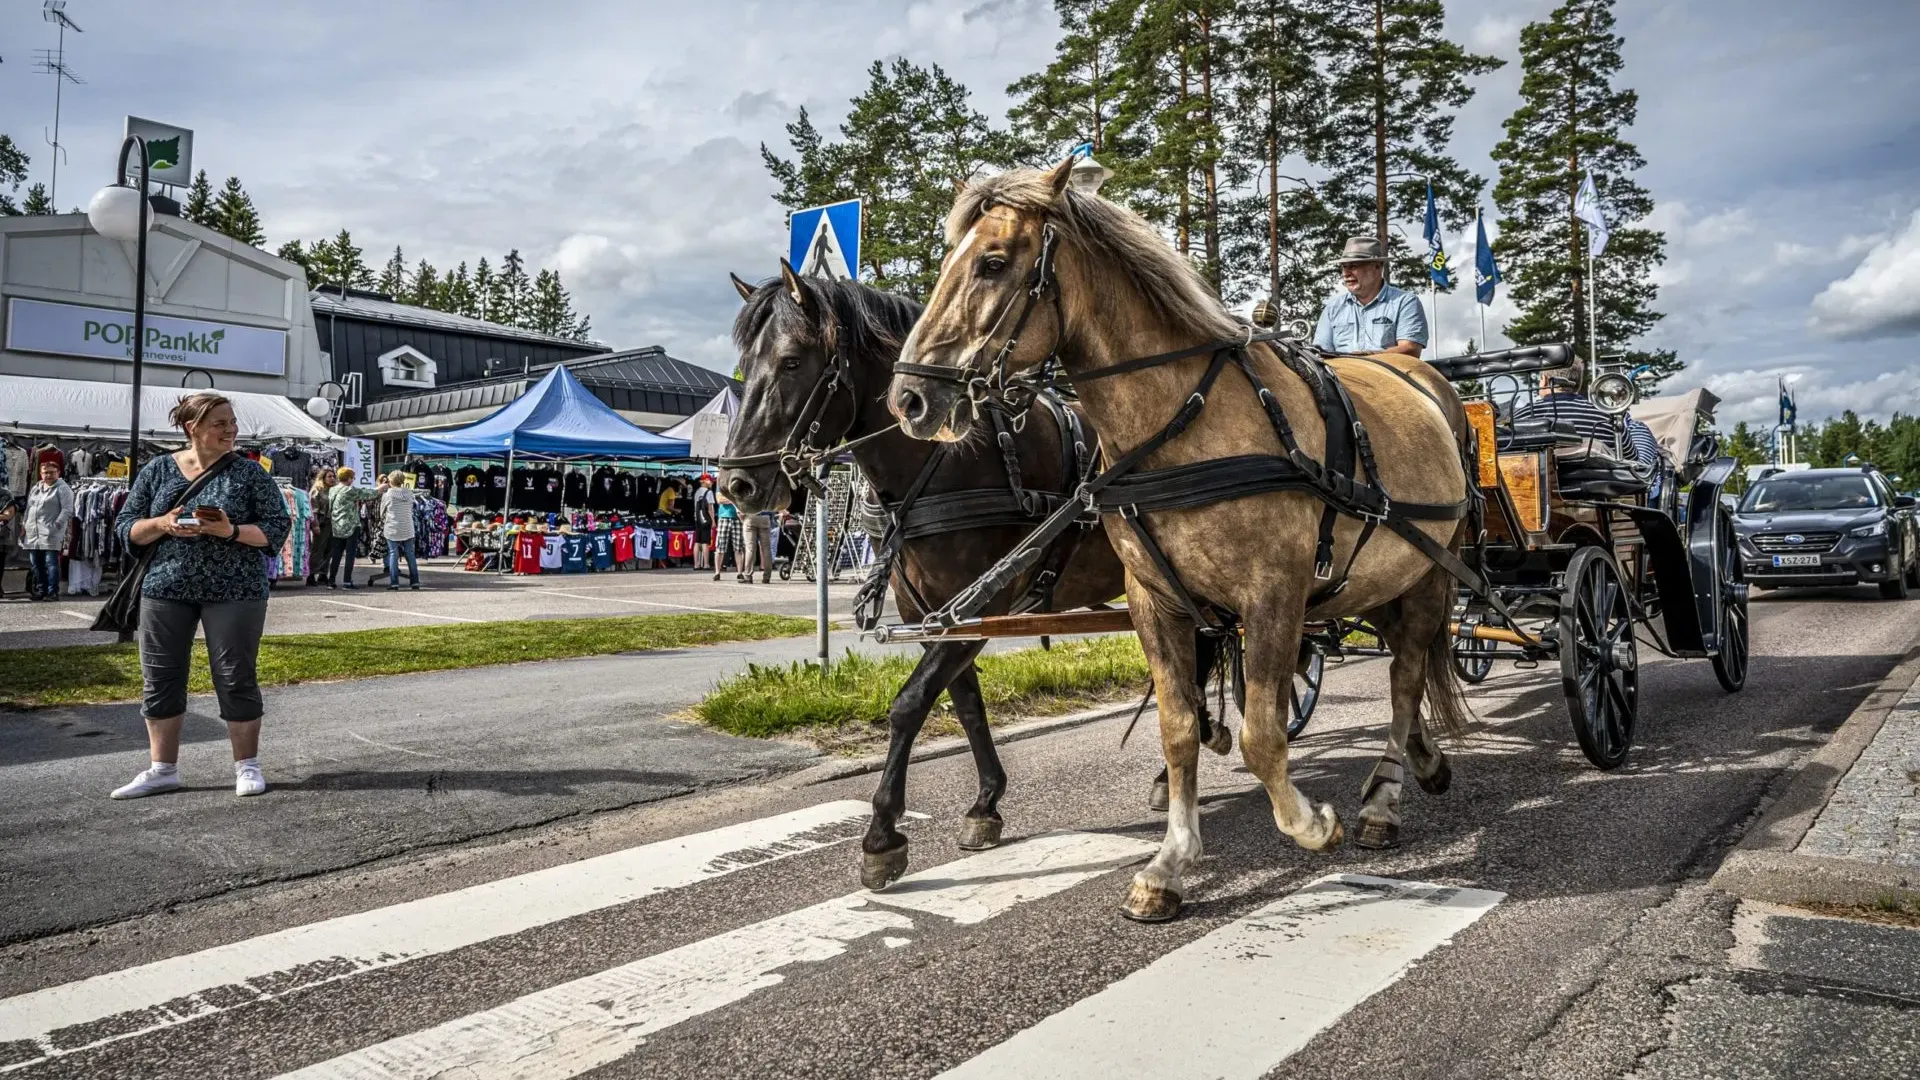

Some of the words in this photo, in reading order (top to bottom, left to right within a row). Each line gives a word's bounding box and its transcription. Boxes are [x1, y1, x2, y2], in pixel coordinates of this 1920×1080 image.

[84, 320, 136, 345] POP
[145, 327, 224, 354] Pankki
[126, 347, 187, 362] Knnevesi
[359, 444, 372, 485] Pankki
[522, 544, 533, 559] 11
[546, 543, 554, 556] 9
[572, 544, 579, 558] 7
